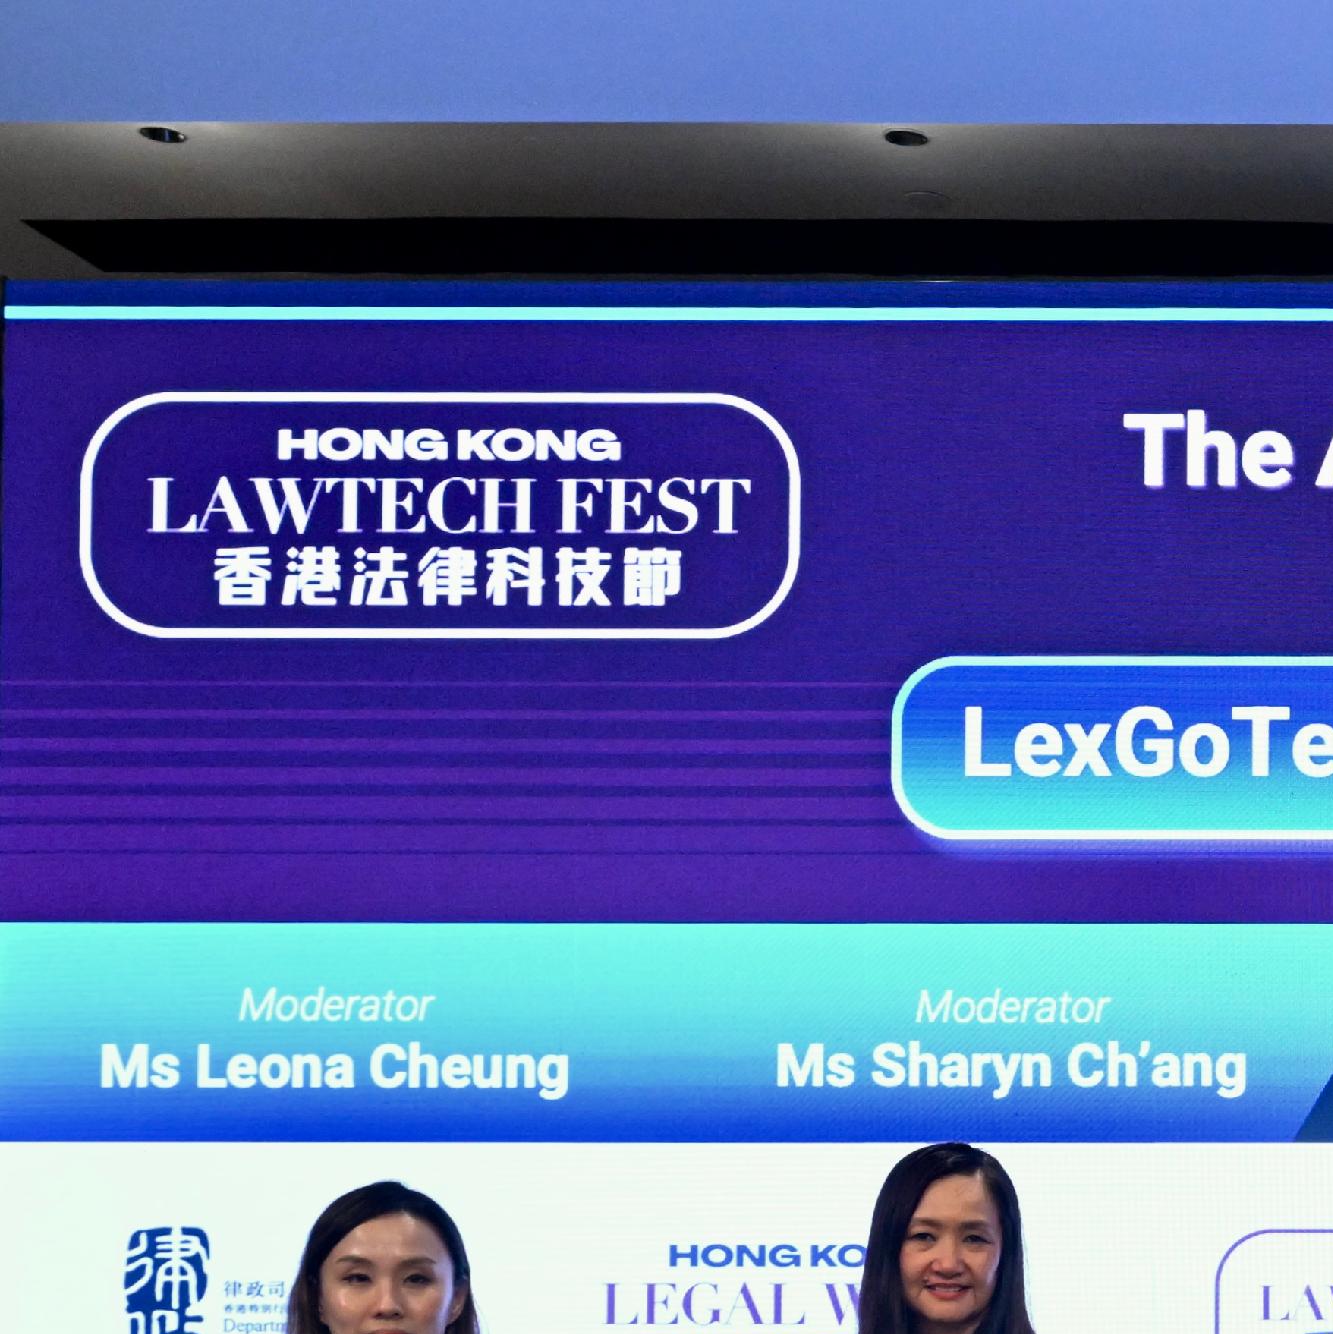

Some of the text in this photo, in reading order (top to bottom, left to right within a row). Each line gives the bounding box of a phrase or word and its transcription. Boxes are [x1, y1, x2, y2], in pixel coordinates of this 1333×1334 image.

[278, 427, 621, 461] HONG KONG
[1123, 409, 1295, 489] The
[147, 476, 751, 534] LAWTECH FEST
[214, 546, 682, 606] 香港法律科技節
[239, 986, 437, 1022] Moderator
[916, 988, 1113, 1024] Moderator
[101, 1041, 569, 1100] Ms Leona Cheung
[776, 1043, 855, 1088] Ms
[871, 1040, 1052, 1099] Sharyn
[669, 1244, 867, 1267] HONG KO
[224, 1281, 284, 1298] 律政司
[606, 1283, 804, 1324] LEGAL
[223, 1318, 284, 1334] Depart
